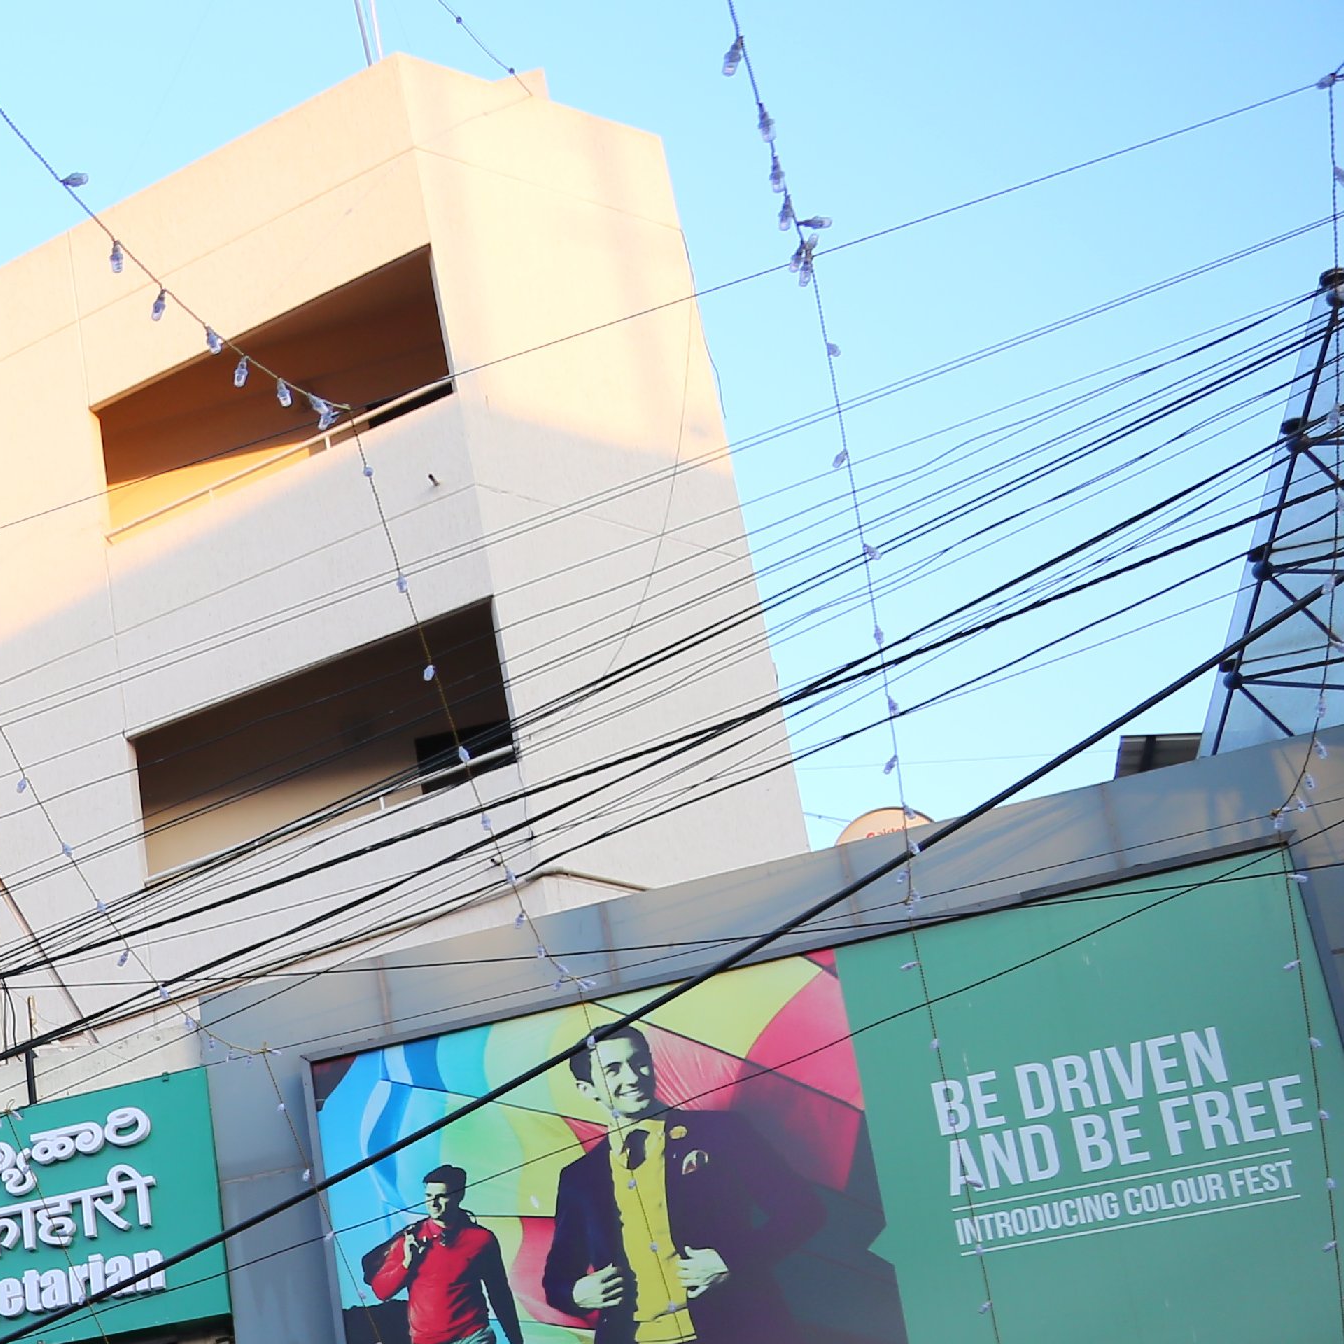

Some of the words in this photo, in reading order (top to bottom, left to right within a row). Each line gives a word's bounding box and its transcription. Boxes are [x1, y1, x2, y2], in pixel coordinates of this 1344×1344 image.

[930, 1070, 1006, 1136] BE
[1014, 1026, 1228, 1120] DRIVEN
[949, 1124, 1061, 1196] AND
[1071, 1105, 1151, 1173] BE
[1159, 1074, 1313, 1156] FREE
[954, 1192, 1120, 1246] INTRODUCING
[1124, 1172, 1226, 1216] COLOUR
[1228, 1159, 1293, 1198] FEST
